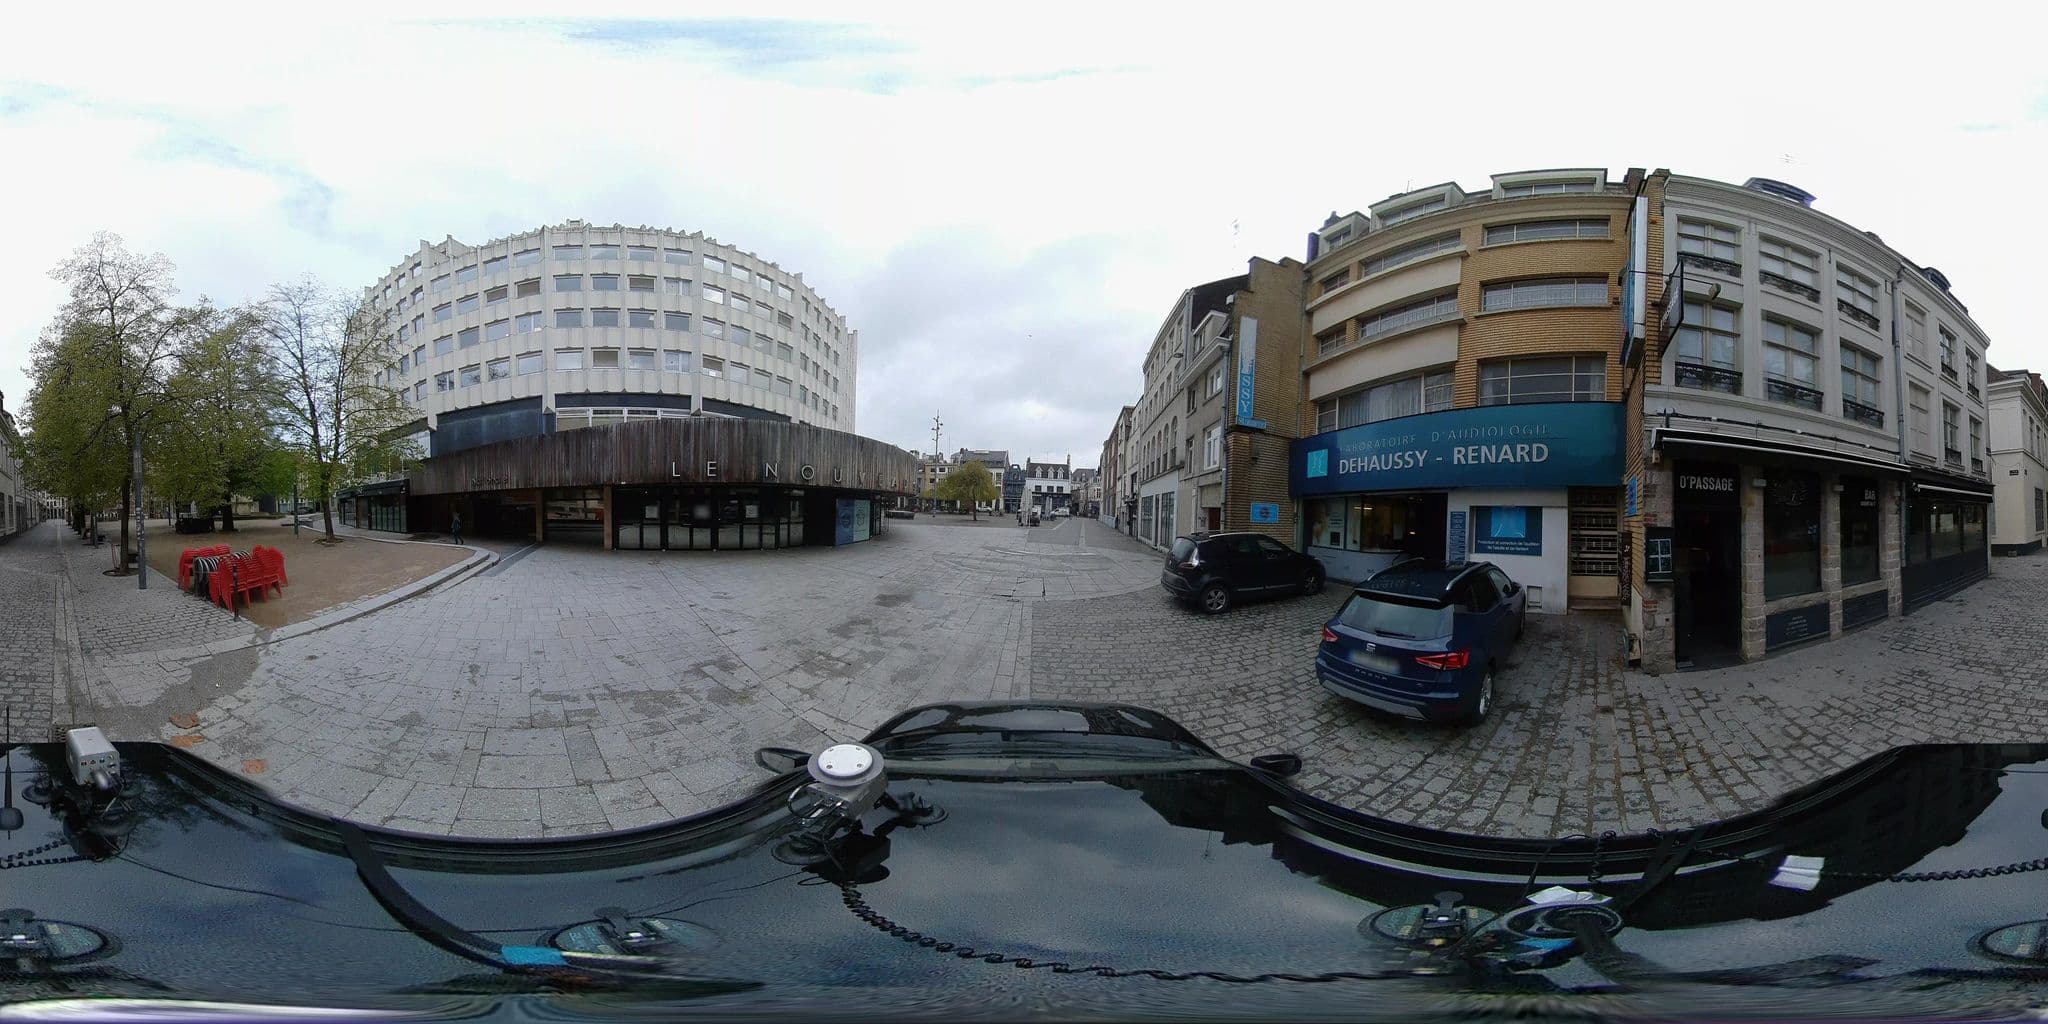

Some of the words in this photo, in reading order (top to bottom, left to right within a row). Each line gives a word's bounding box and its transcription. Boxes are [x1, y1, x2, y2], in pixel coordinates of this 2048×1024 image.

[1339, 449, 1428, 475] DEHAUSSY
[1453, 443, 1549, 465] RENARD
[672, 461, 717, 477] LE
[1680, 475, 1734, 492] O'PASSAGE
